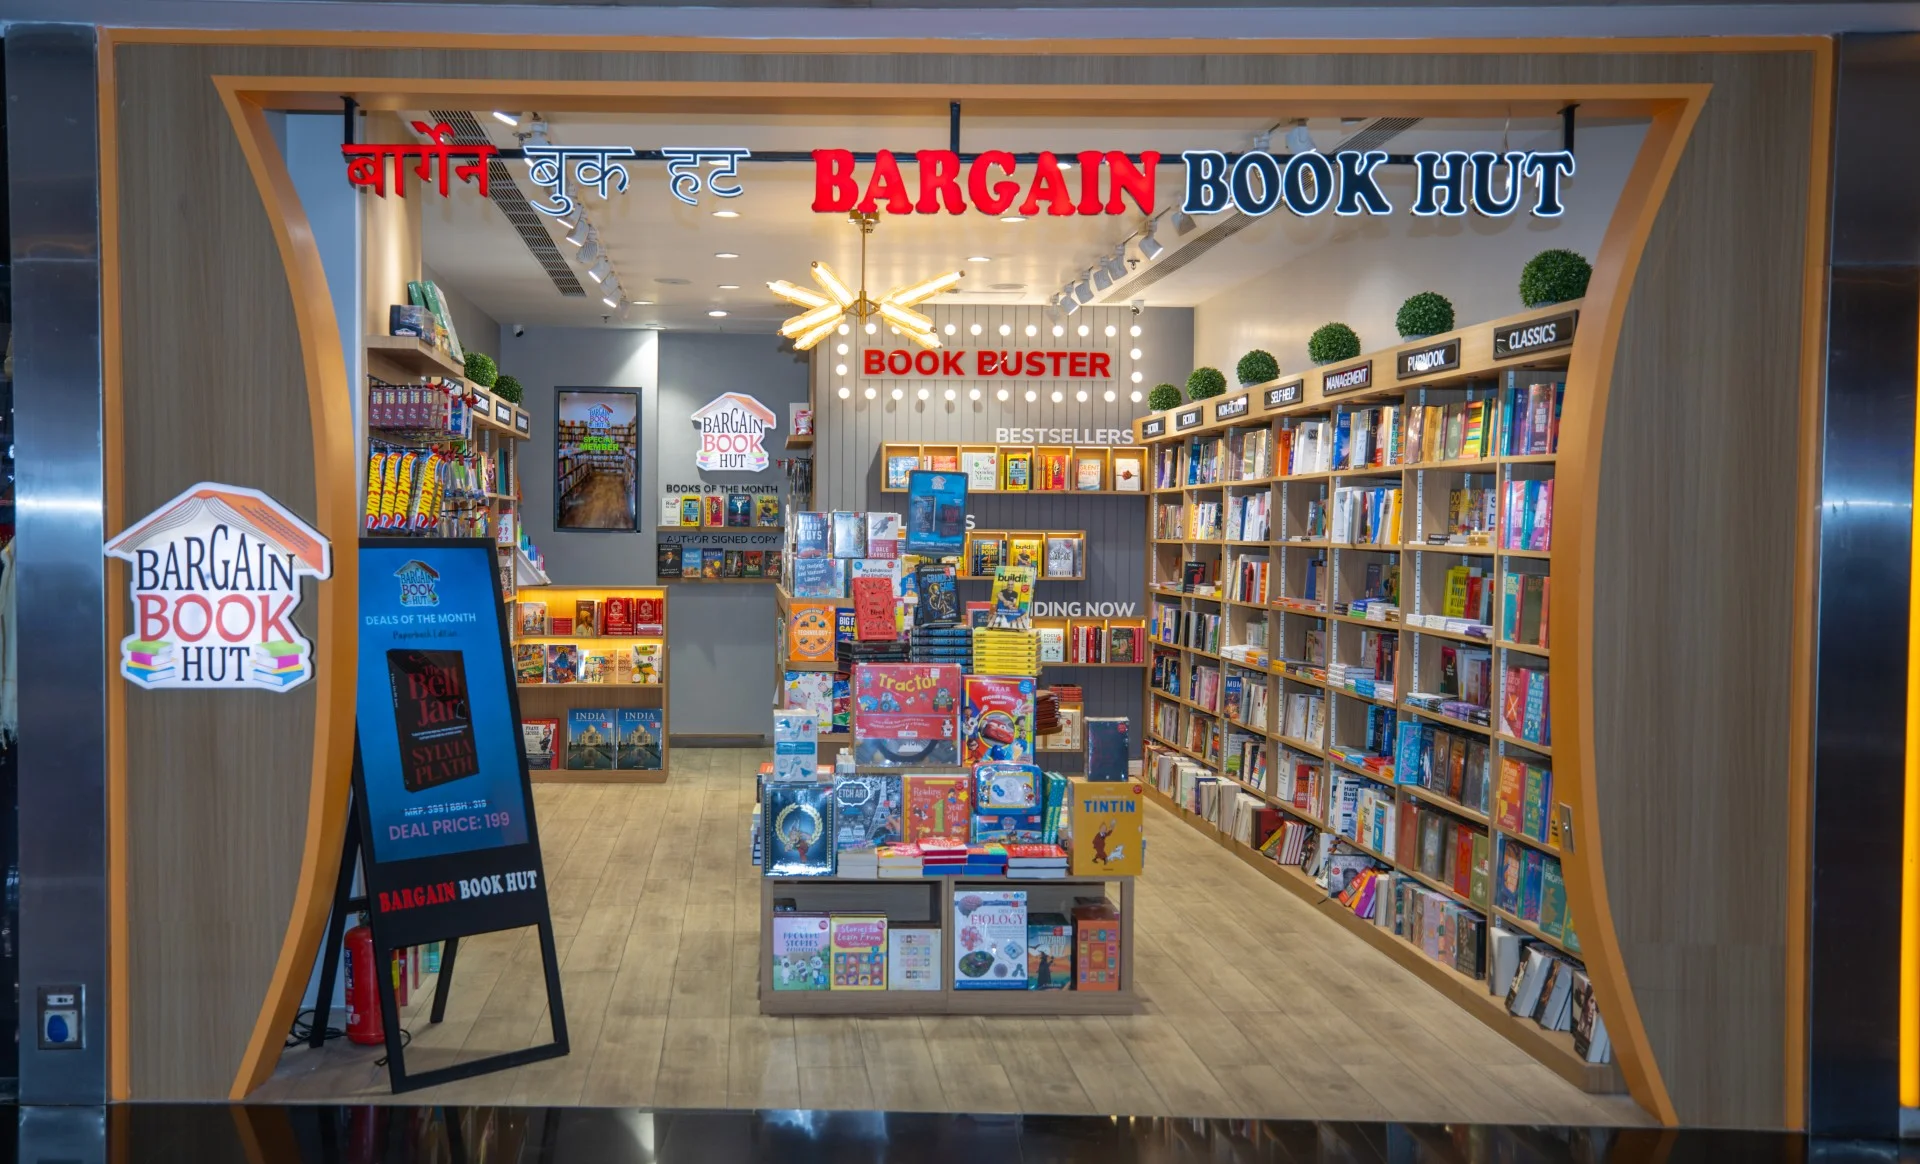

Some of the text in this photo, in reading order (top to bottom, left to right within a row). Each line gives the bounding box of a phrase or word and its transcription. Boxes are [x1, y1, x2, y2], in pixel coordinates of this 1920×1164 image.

[523, 145, 635, 217] बुक
[660, 146, 751, 205] हट
[811, 148, 1576, 218] BARGAIN BOOK HUT
[1509, 323, 1556, 349] CLASSICS
[863, 349, 1112, 378] BOOK BUSTER
[1326, 368, 1368, 391] MANAGEMENT
[703, 407, 763, 434] BARGAIN
[703, 434, 763, 453] BOOK
[996, 427, 1134, 445] BESTSELLERS
[580, 443, 619, 451] MEMBER
[719, 453, 746, 468] HUT
[666, 485, 778, 494] BOOKS OF THE MONTH
[666, 535, 778, 544] AUTHOR SIGNED COPY
[136, 524, 295, 591] BARGAIN
[402, 584, 435, 595] BOOK
[413, 595, 427, 605] HUT
[136, 594, 295, 644] BOOK
[365, 612, 477, 625] DEALS OF THE MONTH
[1030, 602, 1082, 618] DING
[1085, 602, 1136, 618] NOW
[181, 646, 250, 682] HUT
[408, 667, 459, 700] Bell
[879, 673, 938, 692] Tractor
[418, 698, 459, 728] Jar
[575, 712, 606, 720] INDIA
[625, 712, 655, 720] INDIA
[412, 738, 473, 766] SYLVIA
[415, 755, 473, 785] PLATH
[838, 788, 867, 798] ETCH ART
[913, 787, 942, 799] Reading
[1083, 800, 1136, 813] TINTIN
[932, 799, 945, 833] 1
[388, 811, 510, 841] DEAL PRICE: 199
[378, 870, 538, 913] BARGAIN BOOK HUT
[971, 914, 1024, 925] BIOLOGY
[839, 925, 866, 934] Stories
[860, 934, 881, 942] From
[1038, 935, 1067, 945] WIZARD
